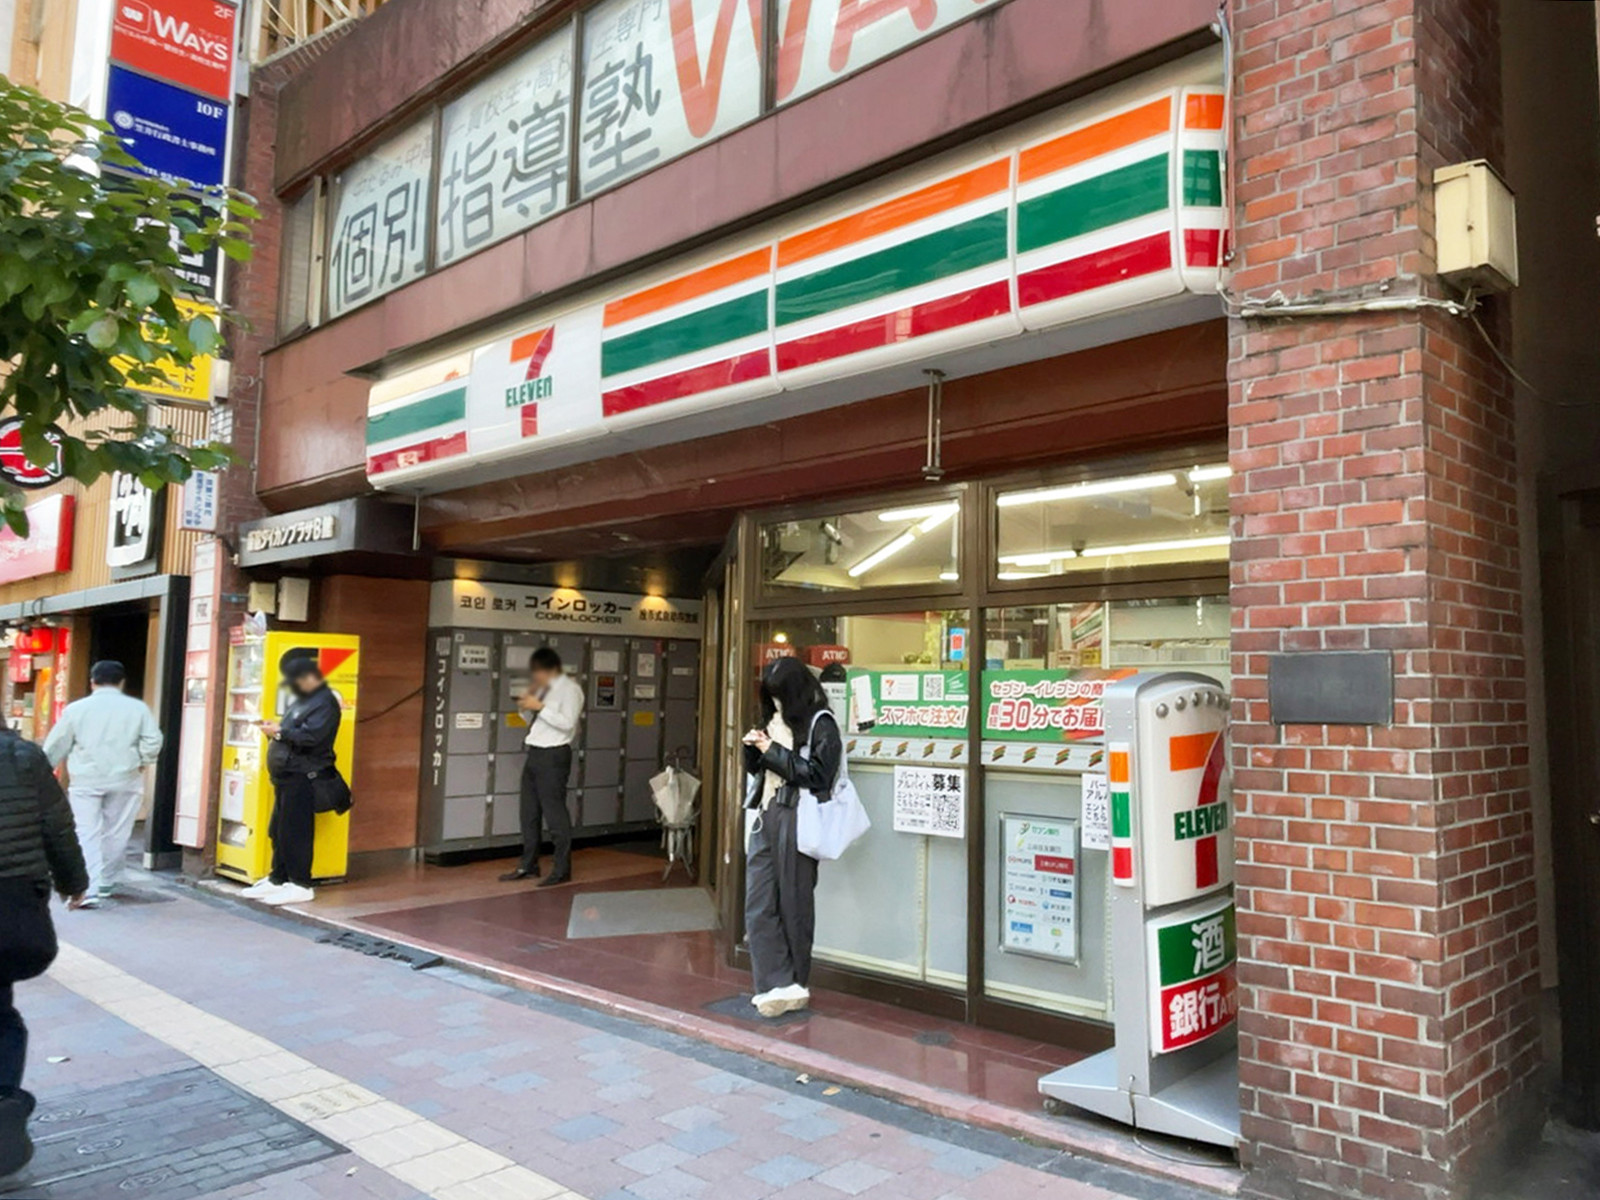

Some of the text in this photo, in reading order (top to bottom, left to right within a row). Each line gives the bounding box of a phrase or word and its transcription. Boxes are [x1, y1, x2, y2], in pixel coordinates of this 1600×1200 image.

[153, 10, 228, 60] WAYS
[214, 5, 233, 18] 2F
[196, 101, 223, 118] 10F
[510, 324, 555, 437] 7
[524, 595, 632, 614] コインロッカー
[433, 659, 447, 786] コインロッカー
[932, 773, 961, 793] 募集
[1169, 730, 1226, 889] 7
[1191, 915, 1224, 974] 酒
[1169, 982, 1220, 1040] 銀行
